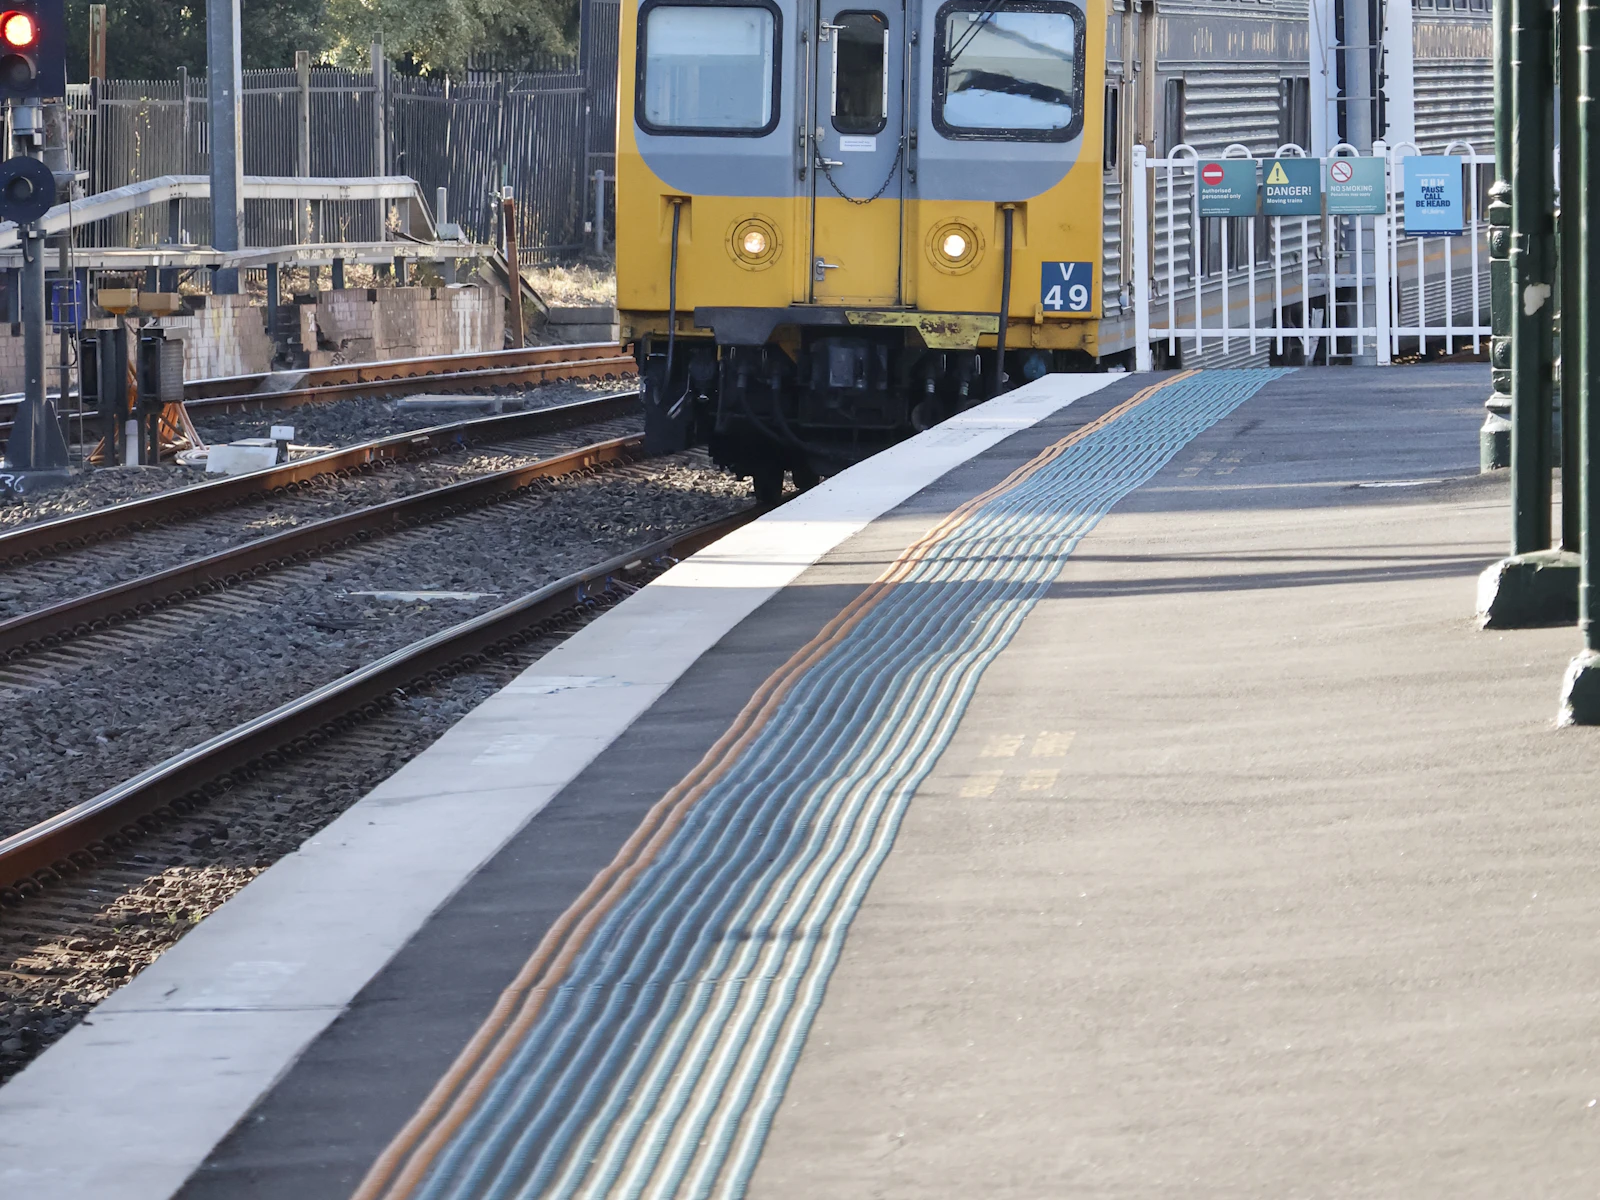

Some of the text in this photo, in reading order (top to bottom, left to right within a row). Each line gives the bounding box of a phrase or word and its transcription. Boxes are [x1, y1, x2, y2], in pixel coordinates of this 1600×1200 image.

[1266, 185, 1312, 196] DANGER!
[1202, 193, 1242, 201] personnel only
[1266, 197, 1287, 205] Moving
[1059, 263, 1075, 281] V
[1043, 284, 1089, 311] 49
